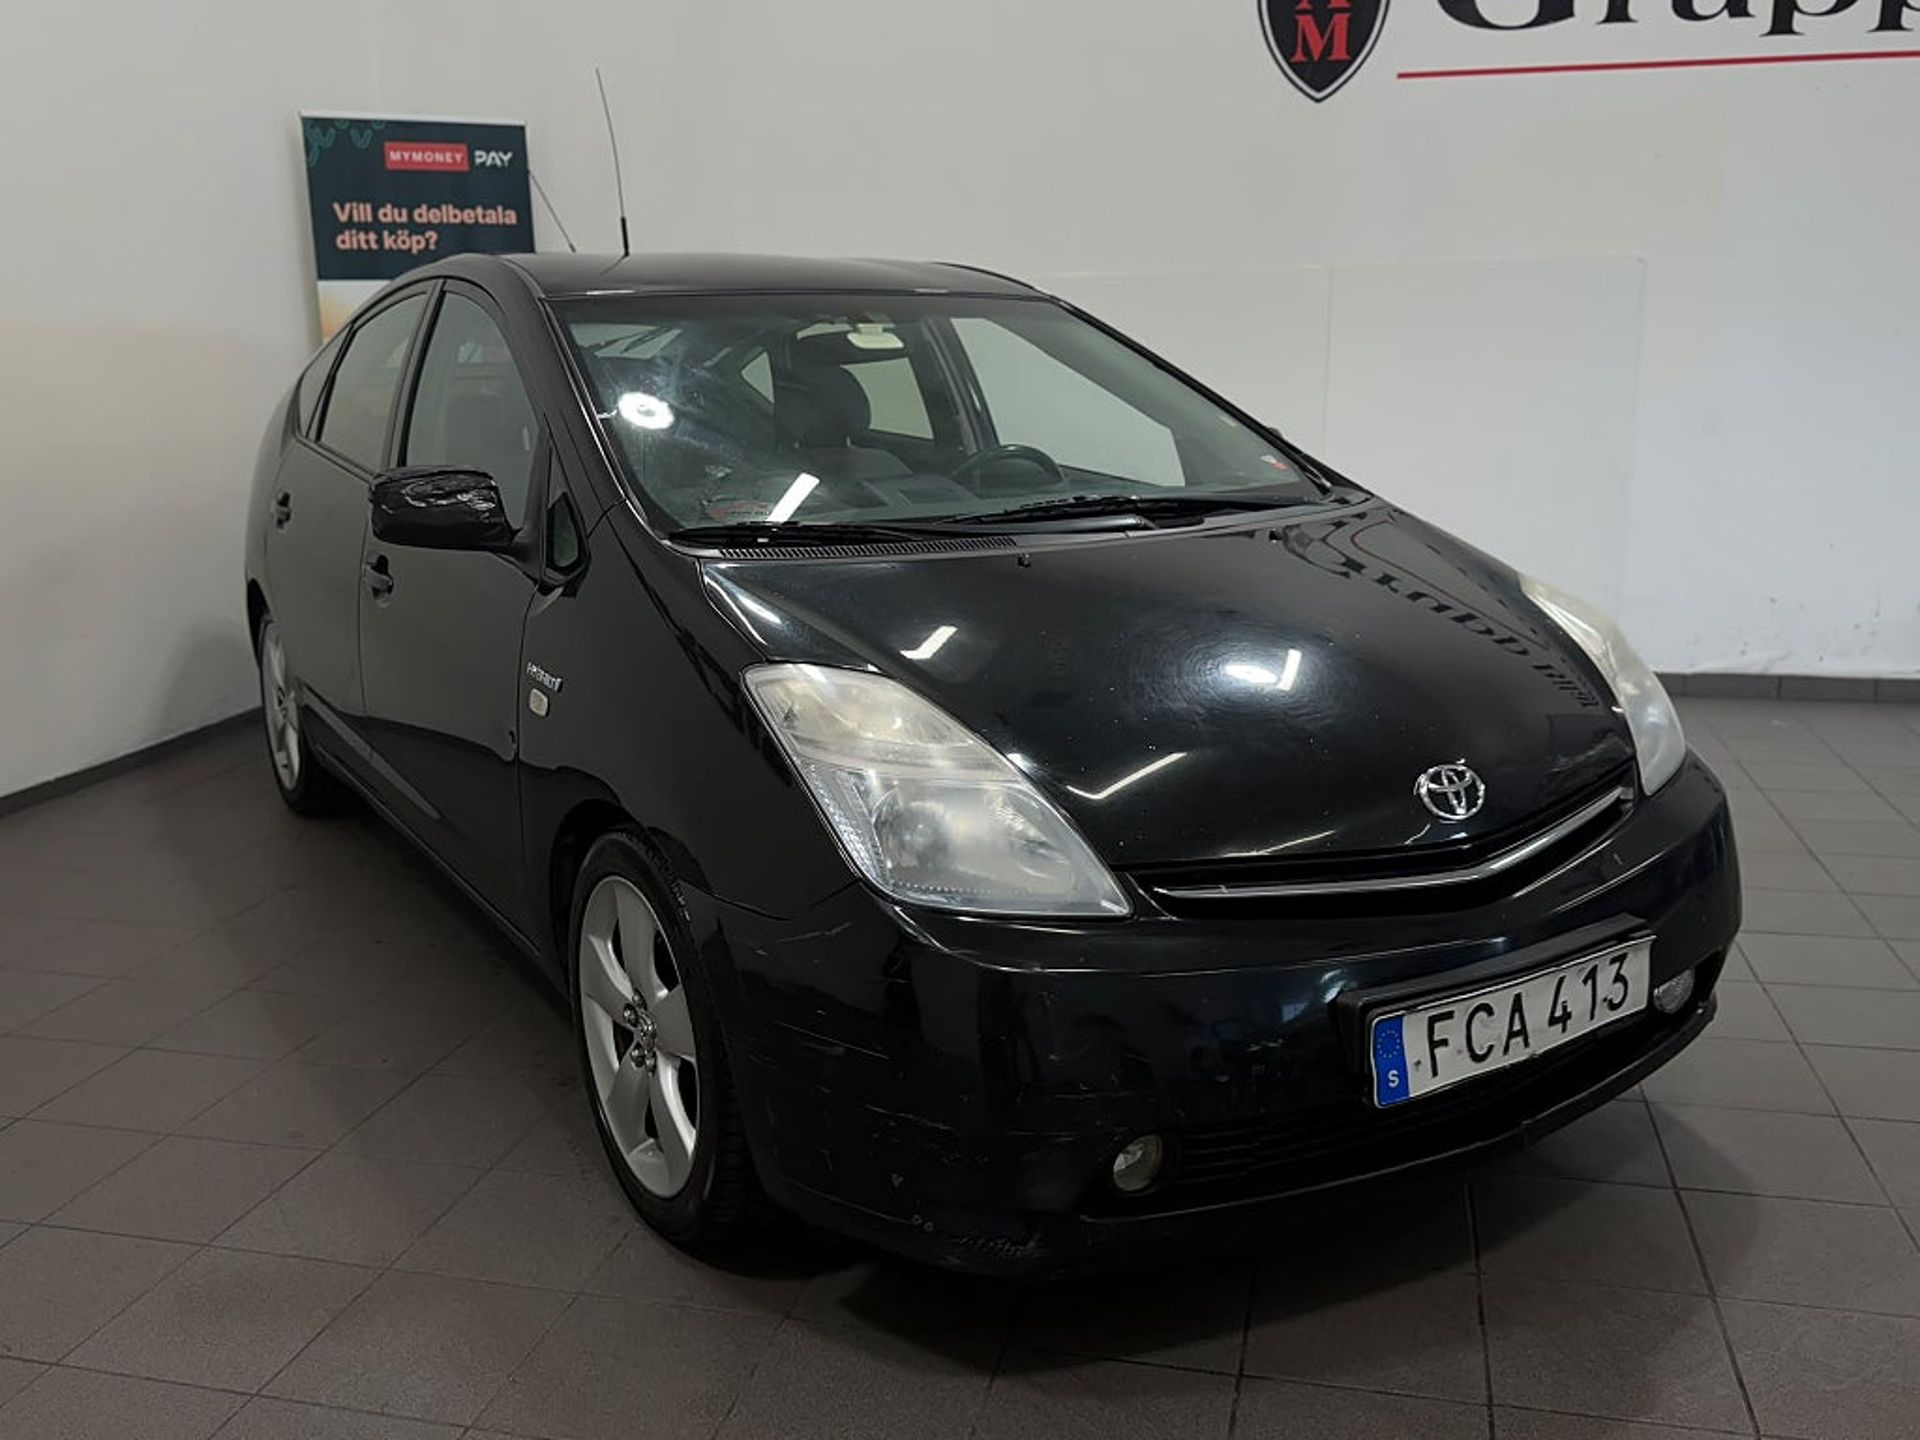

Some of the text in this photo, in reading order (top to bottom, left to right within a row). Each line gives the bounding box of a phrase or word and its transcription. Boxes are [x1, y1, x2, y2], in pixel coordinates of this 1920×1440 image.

[389, 149, 513, 167] MYMONEY PAY
[333, 202, 517, 225] Vill du delbetala
[336, 228, 438, 254] ditt köp?
[1426, 951, 1630, 1079] FCA 413
[1388, 1069, 1400, 1088] S
